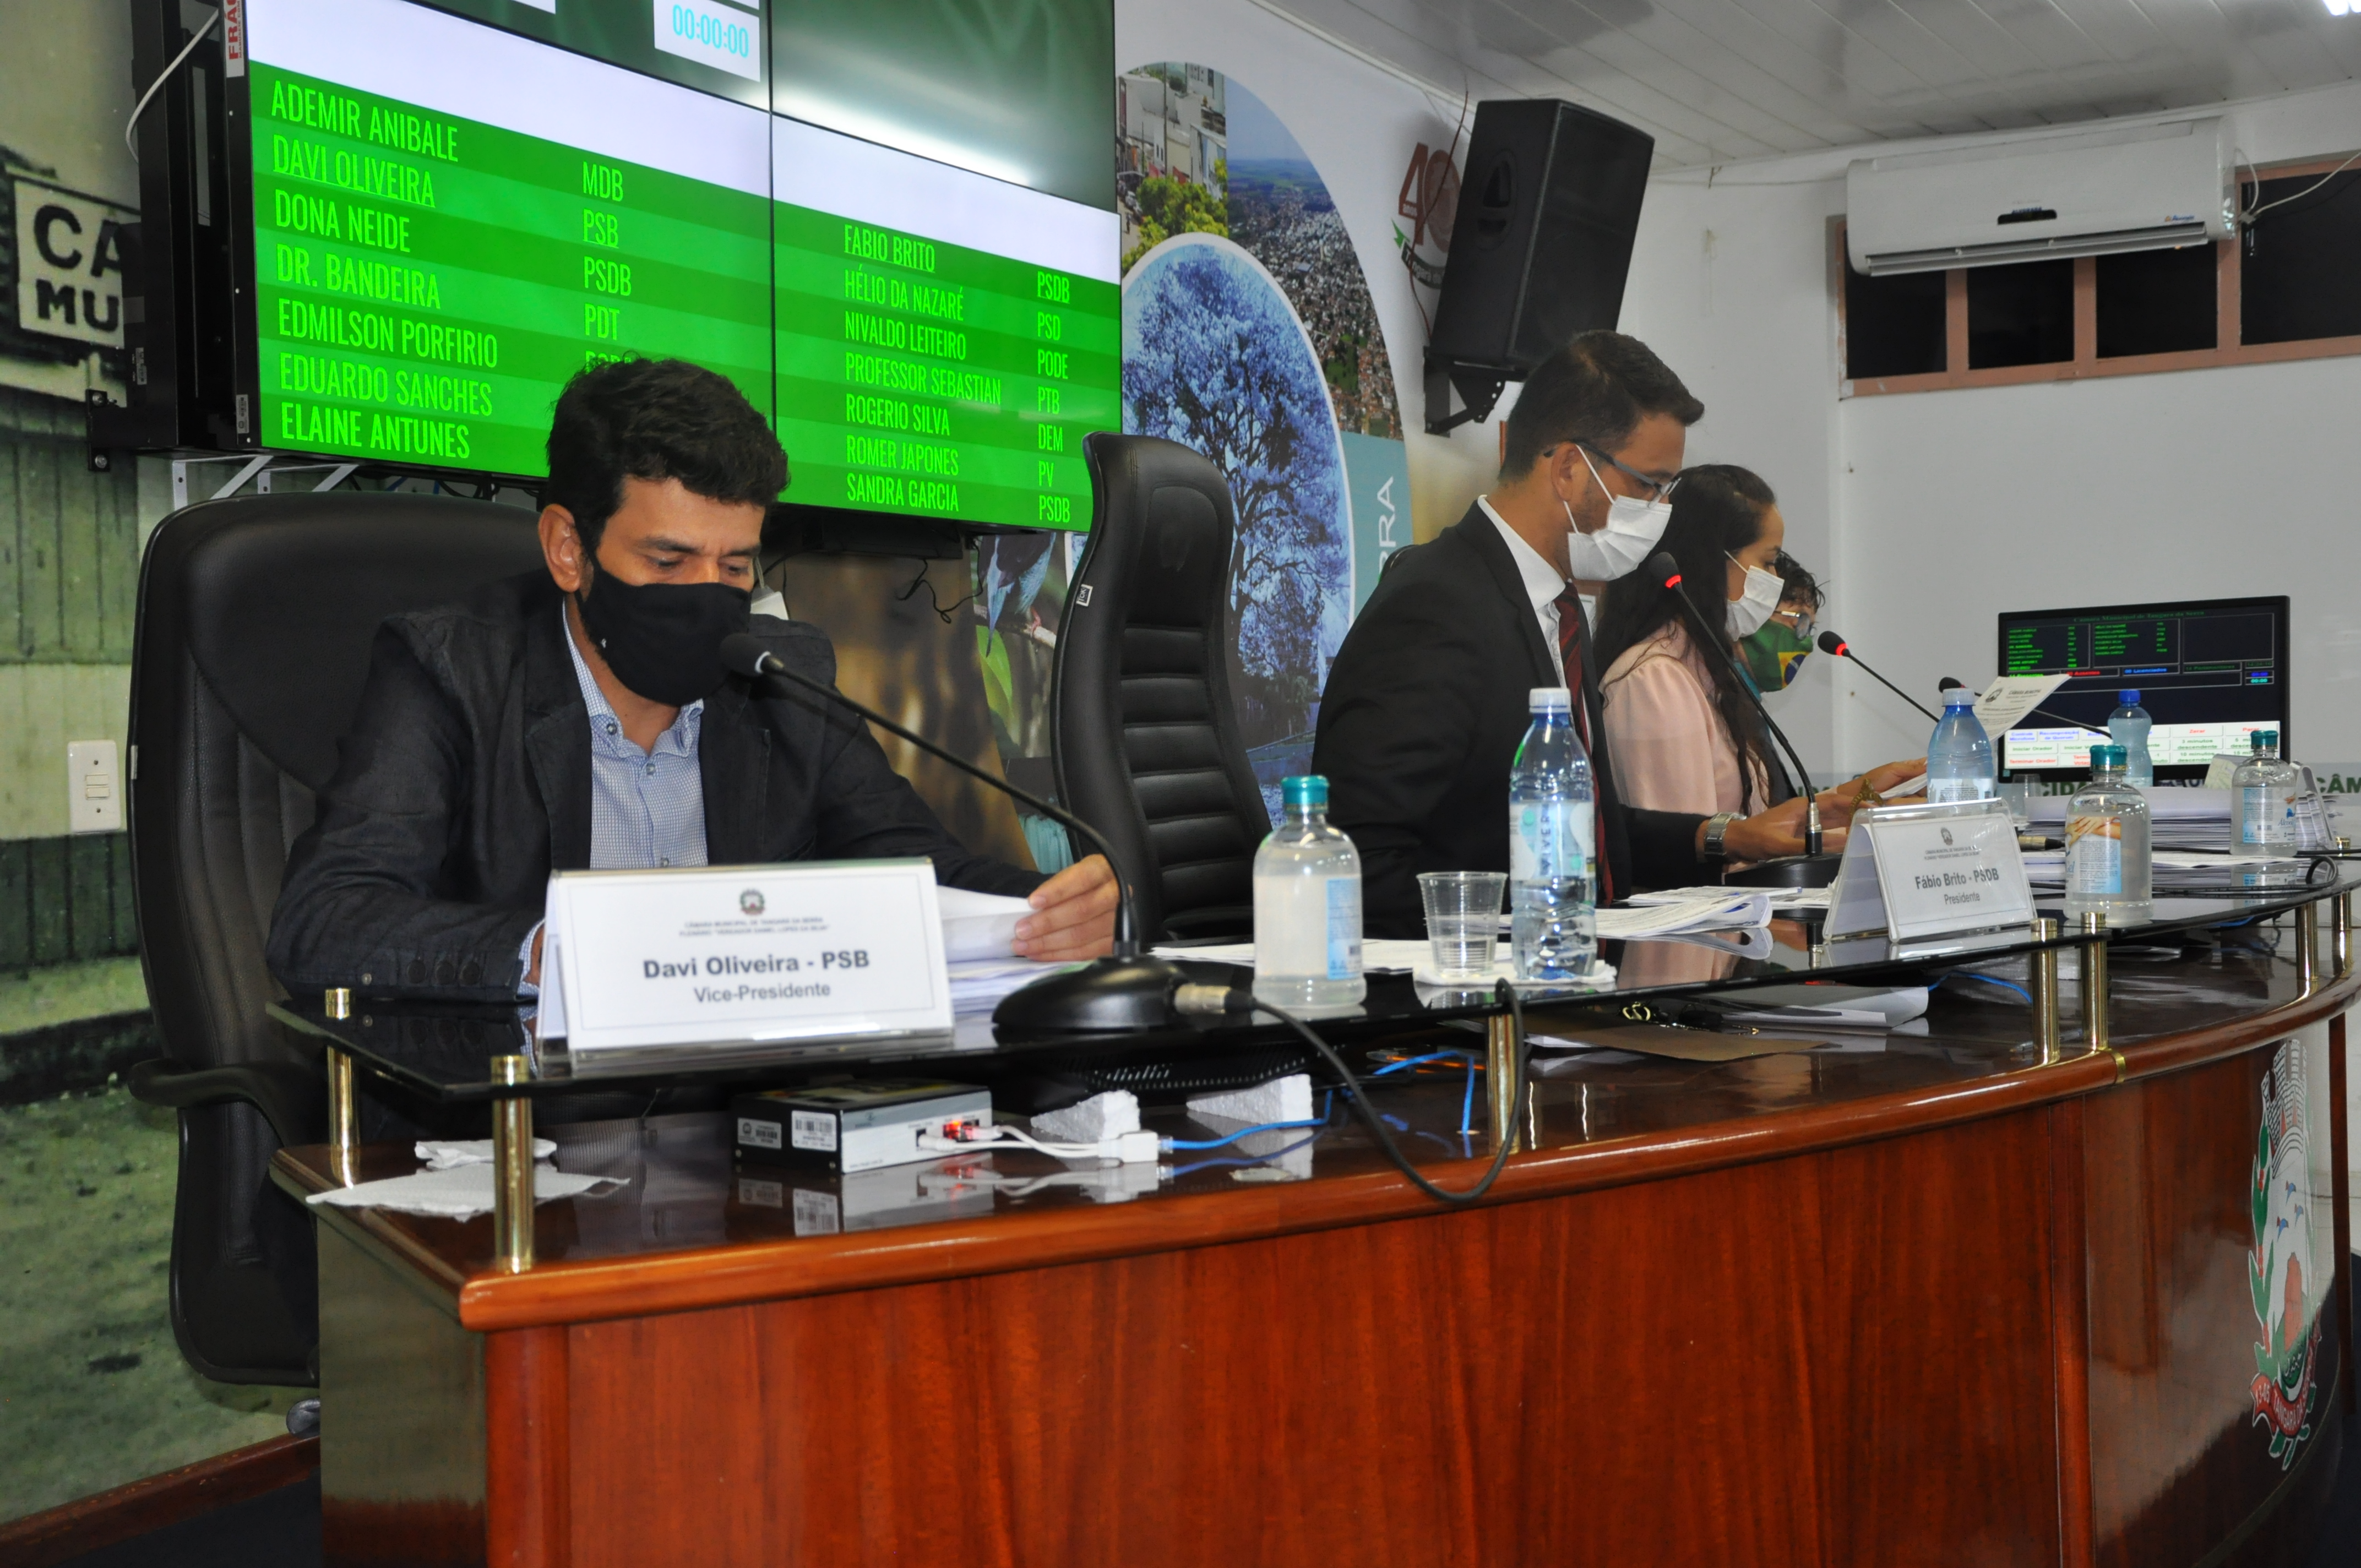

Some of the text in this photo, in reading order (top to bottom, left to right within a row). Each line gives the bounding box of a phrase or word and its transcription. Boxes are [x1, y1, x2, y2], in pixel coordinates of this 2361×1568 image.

[672, 4, 749, 58] 00:00:00
[271, 80, 459, 162] ADEMIR ANIBALE
[273, 134, 436, 207] DAVI OLIVEIRA
[583, 161, 623, 202] MDB
[275, 189, 411, 253] DONA NEIDE
[584, 209, 619, 248] PSB
[845, 224, 935, 272] FABIO BRITO
[277, 243, 441, 309] DR. BANDEIRA
[584, 256, 632, 296] PSDB
[845, 264, 964, 321] HÉLIO DA NAZARÉ
[1037, 271, 1070, 303] PSDB
[36, 279, 120, 332] MU
[585, 303, 620, 340] PDT
[1037, 311, 1061, 341] PSD
[279, 298, 498, 368] EDMILSON PORFIRIO
[845, 311, 966, 361] NIVALDO LEITEIRO
[280, 352, 493, 417] EDUARDO SANCHES
[845, 352, 1002, 405] PROFESSOR SEBASTIAN
[1037, 349, 1069, 380] PODE
[846, 393, 950, 437] ROGERIO SILVA
[1038, 385, 1060, 415] PTB
[281, 401, 362, 447] ELAINE
[370, 413, 470, 459] ANTUNES
[1038, 423, 1063, 452] DEM
[846, 434, 959, 476] ROMER JAPONES
[1038, 460, 1054, 487] PV
[847, 472, 959, 512] SANDRA GARCIA
[1039, 494, 1070, 524] PSDB
[1915, 874, 1942, 890] Fábio
[1944, 872, 1967, 886] Brito
[1973, 868, 2000, 884] PSDB
[1944, 892, 1981, 905] Presidente
[643, 958, 698, 979] Davi
[705, 953, 800, 977] Oliveira
[822, 949, 871, 970] PSB
[694, 982, 831, 1004] Vice-Presidente
